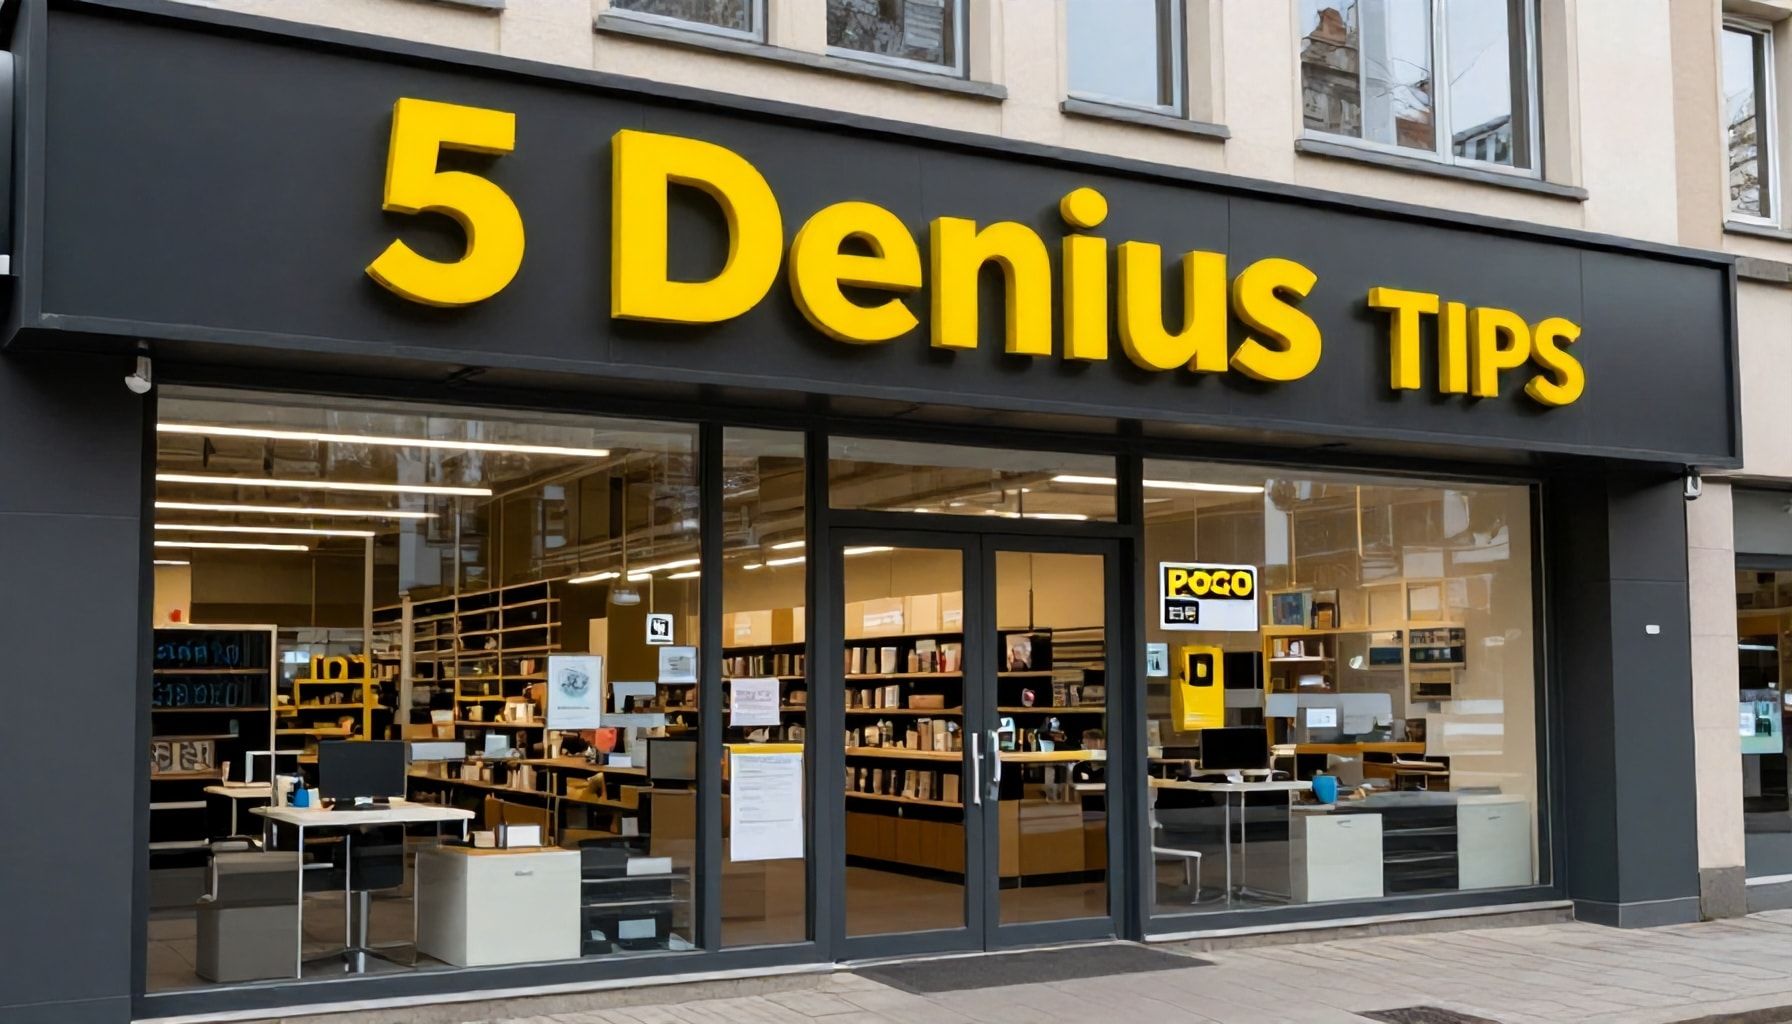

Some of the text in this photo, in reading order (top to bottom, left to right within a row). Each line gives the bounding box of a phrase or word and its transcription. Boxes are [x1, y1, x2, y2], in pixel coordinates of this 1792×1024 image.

[365, 97, 1586, 406] 5 Denius TIPS
